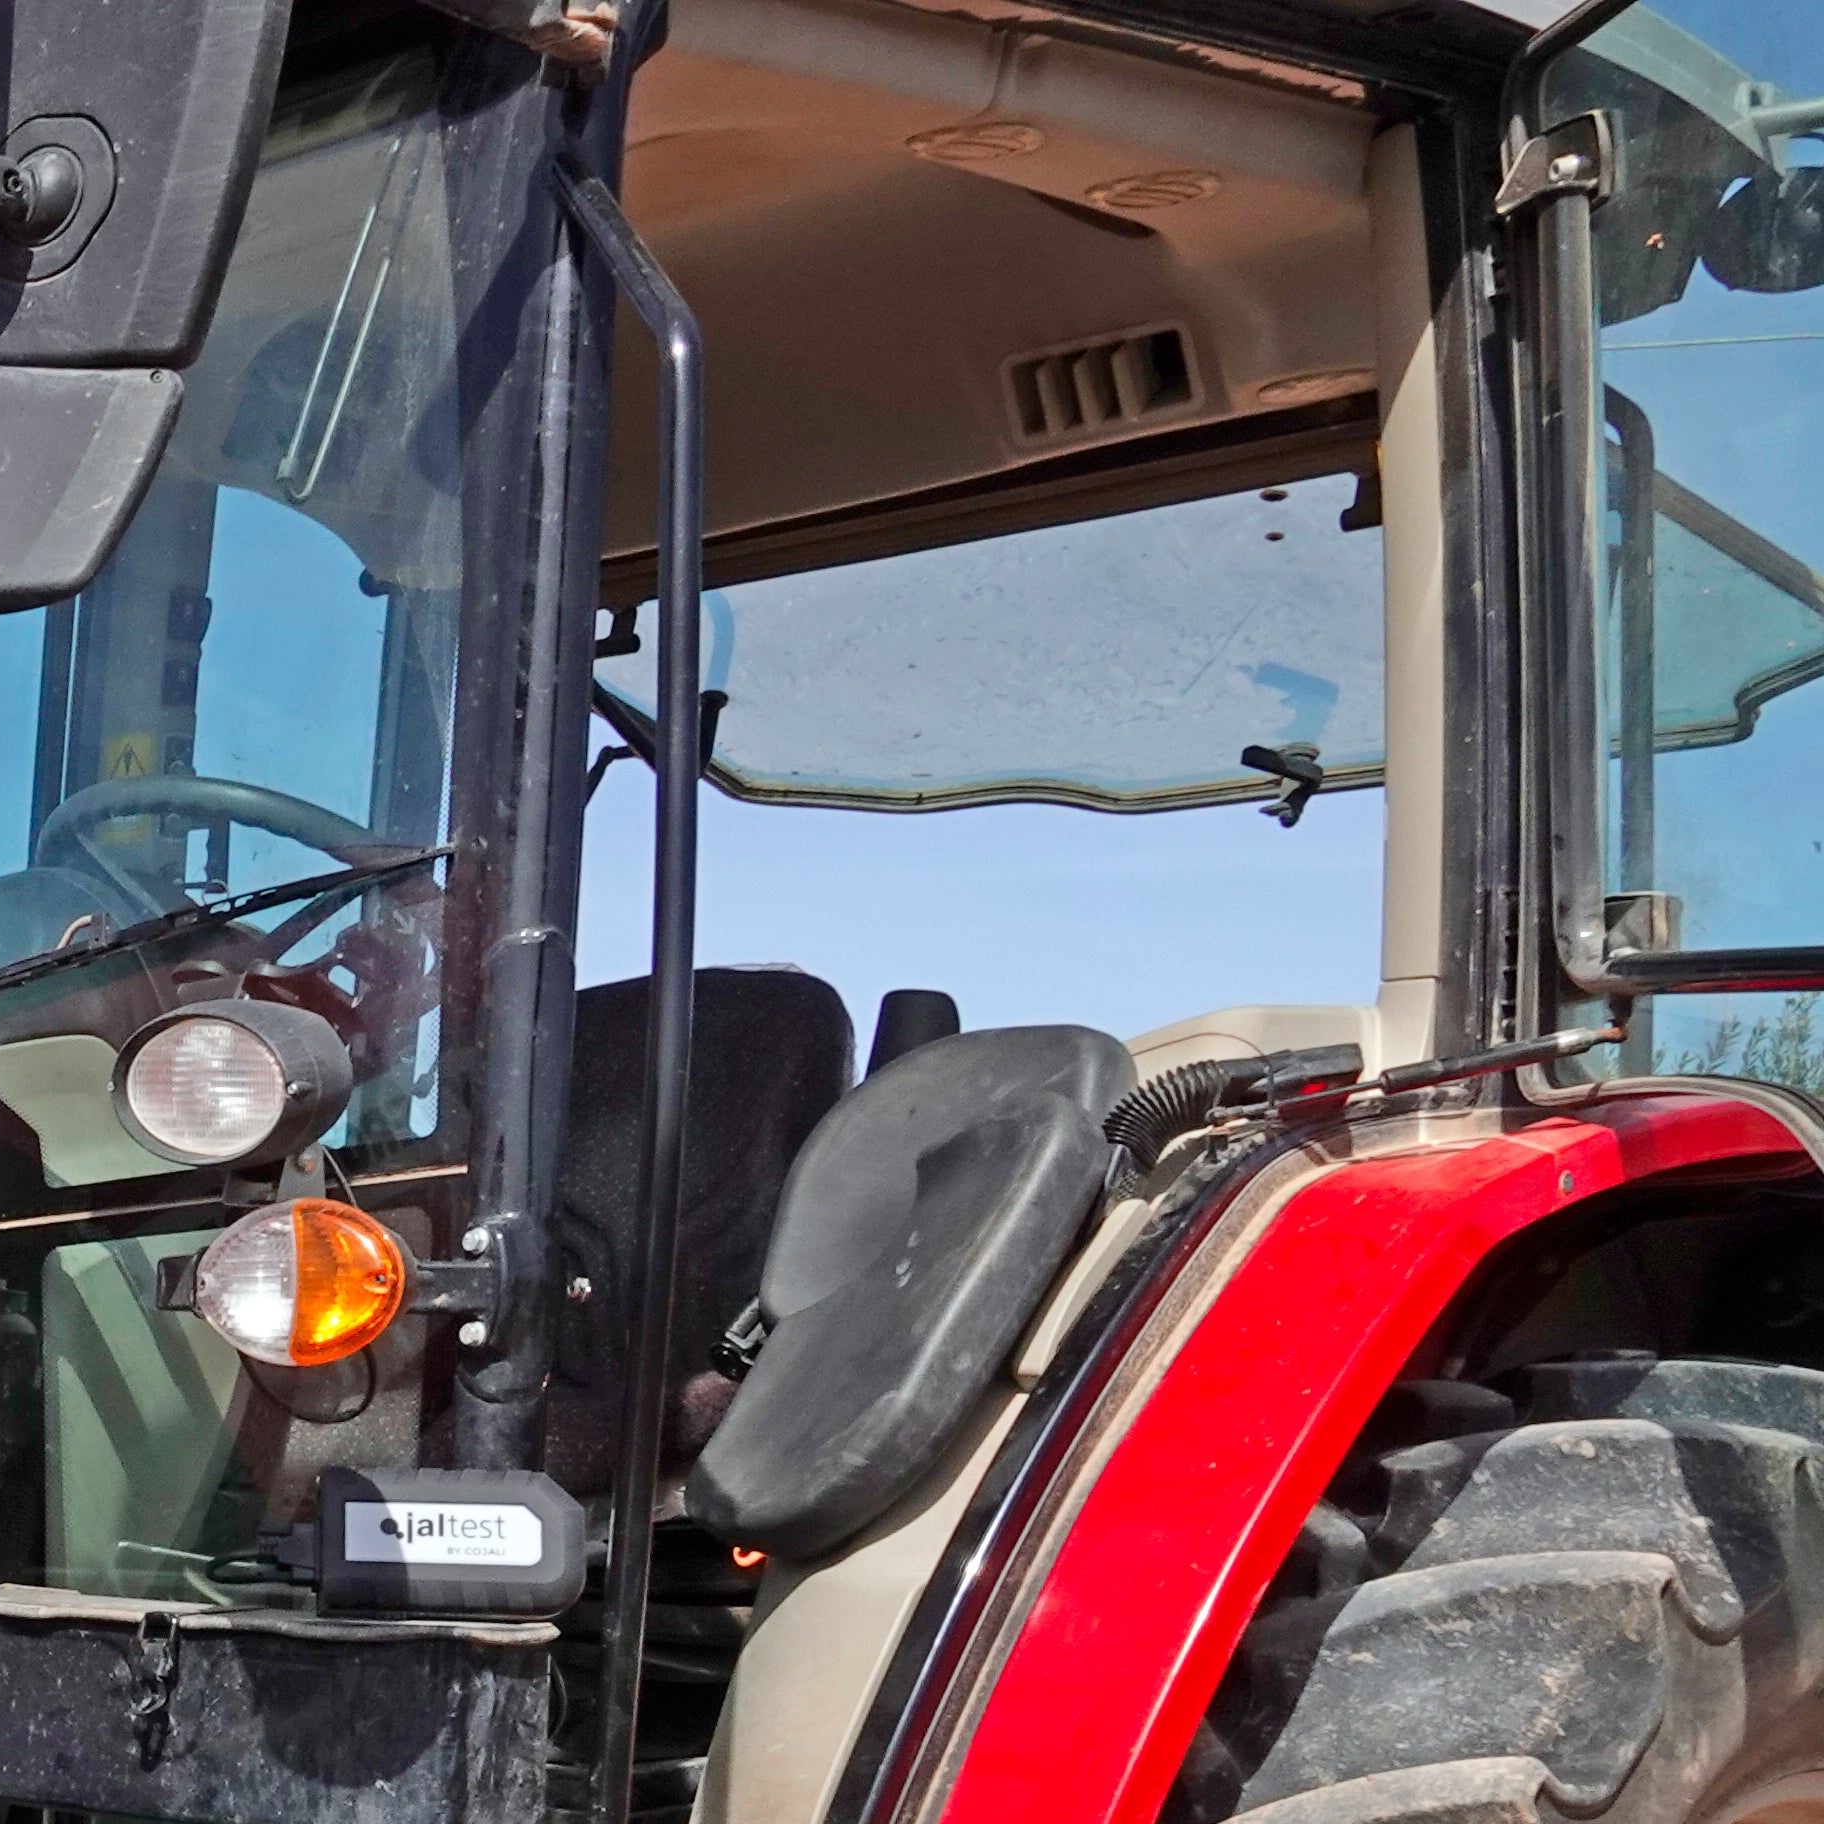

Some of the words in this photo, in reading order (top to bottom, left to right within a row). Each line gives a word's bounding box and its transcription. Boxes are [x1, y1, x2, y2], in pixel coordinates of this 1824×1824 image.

[407, 1512, 505, 1543] jaltest
[447, 1547, 461, 1555] BY
[465, 1548, 506, 1556] COJALI
